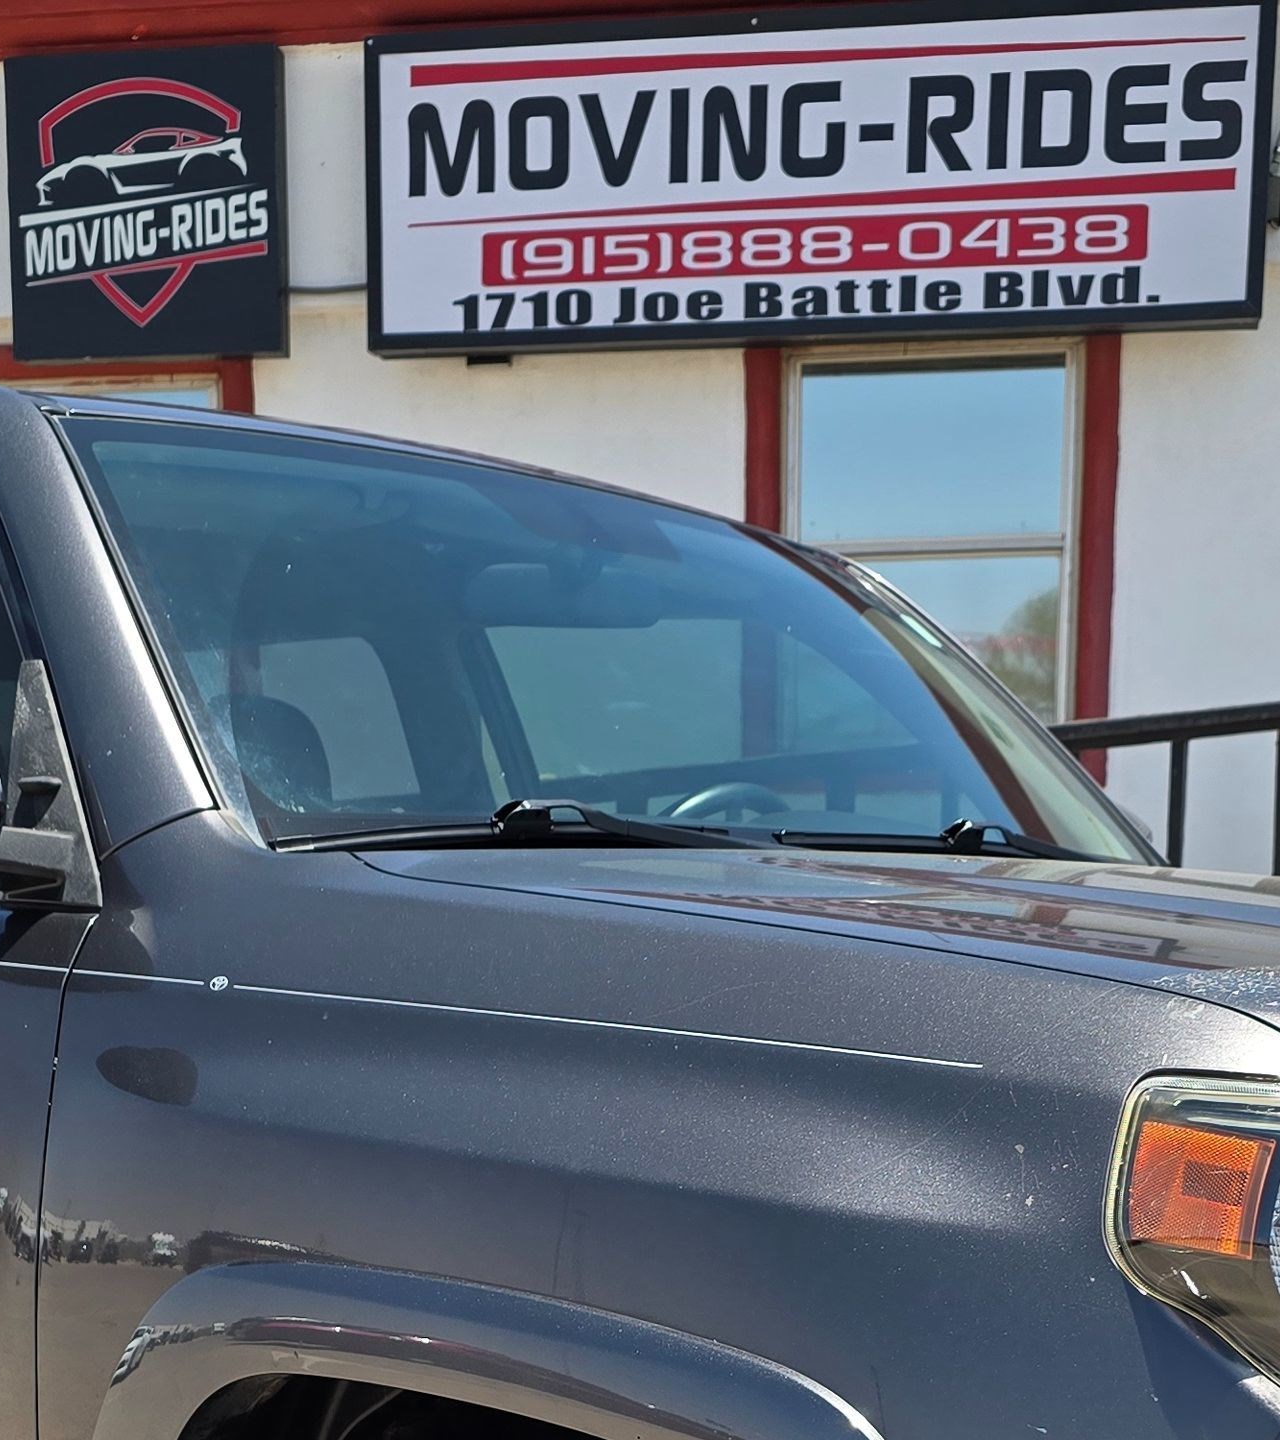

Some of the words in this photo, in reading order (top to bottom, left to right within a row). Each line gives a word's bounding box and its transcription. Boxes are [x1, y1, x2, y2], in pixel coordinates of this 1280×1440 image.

[408, 60, 1248, 197] MOVING-RIDES
[25, 189, 268, 277] MOVING-RIDES
[500, 214, 1130, 281] (915)888-0438
[453, 288, 593, 333] 1710
[614, 286, 723, 325] Joe
[744, 275, 962, 319] Battle
[983, 266, 1160, 310] Blvd.
